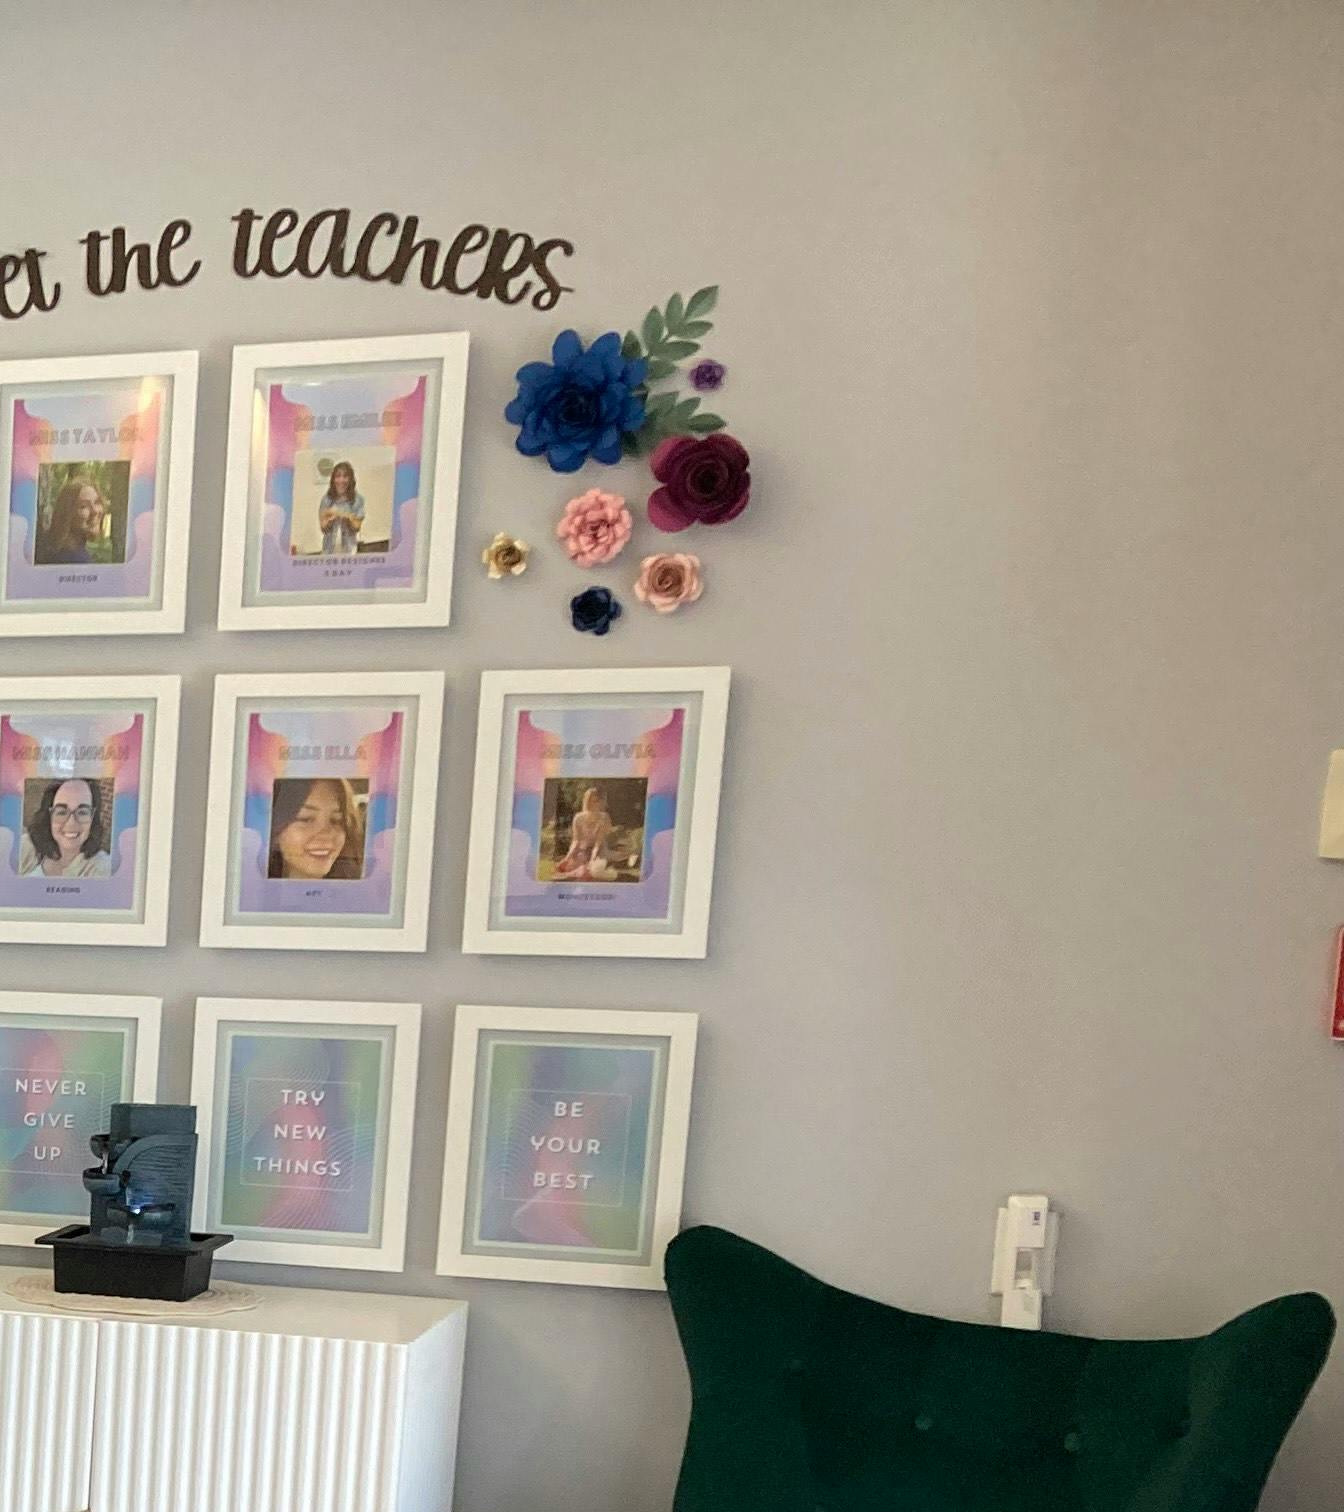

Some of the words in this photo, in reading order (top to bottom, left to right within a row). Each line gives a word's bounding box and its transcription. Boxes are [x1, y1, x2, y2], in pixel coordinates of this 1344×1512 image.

[78, 219, 201, 296] the
[231, 208, 574, 311] teachers
[15, 1078, 87, 1096] NEVER
[280, 1089, 325, 1106] TRY
[554, 1101, 584, 1117] BE
[23, 1112, 75, 1129] GIVE
[274, 1124, 327, 1140] NEW
[530, 1135, 601, 1154] YOUR
[34, 1146, 61, 1161] UP
[252, 1156, 342, 1177] THINGS
[533, 1171, 594, 1190] BEST
